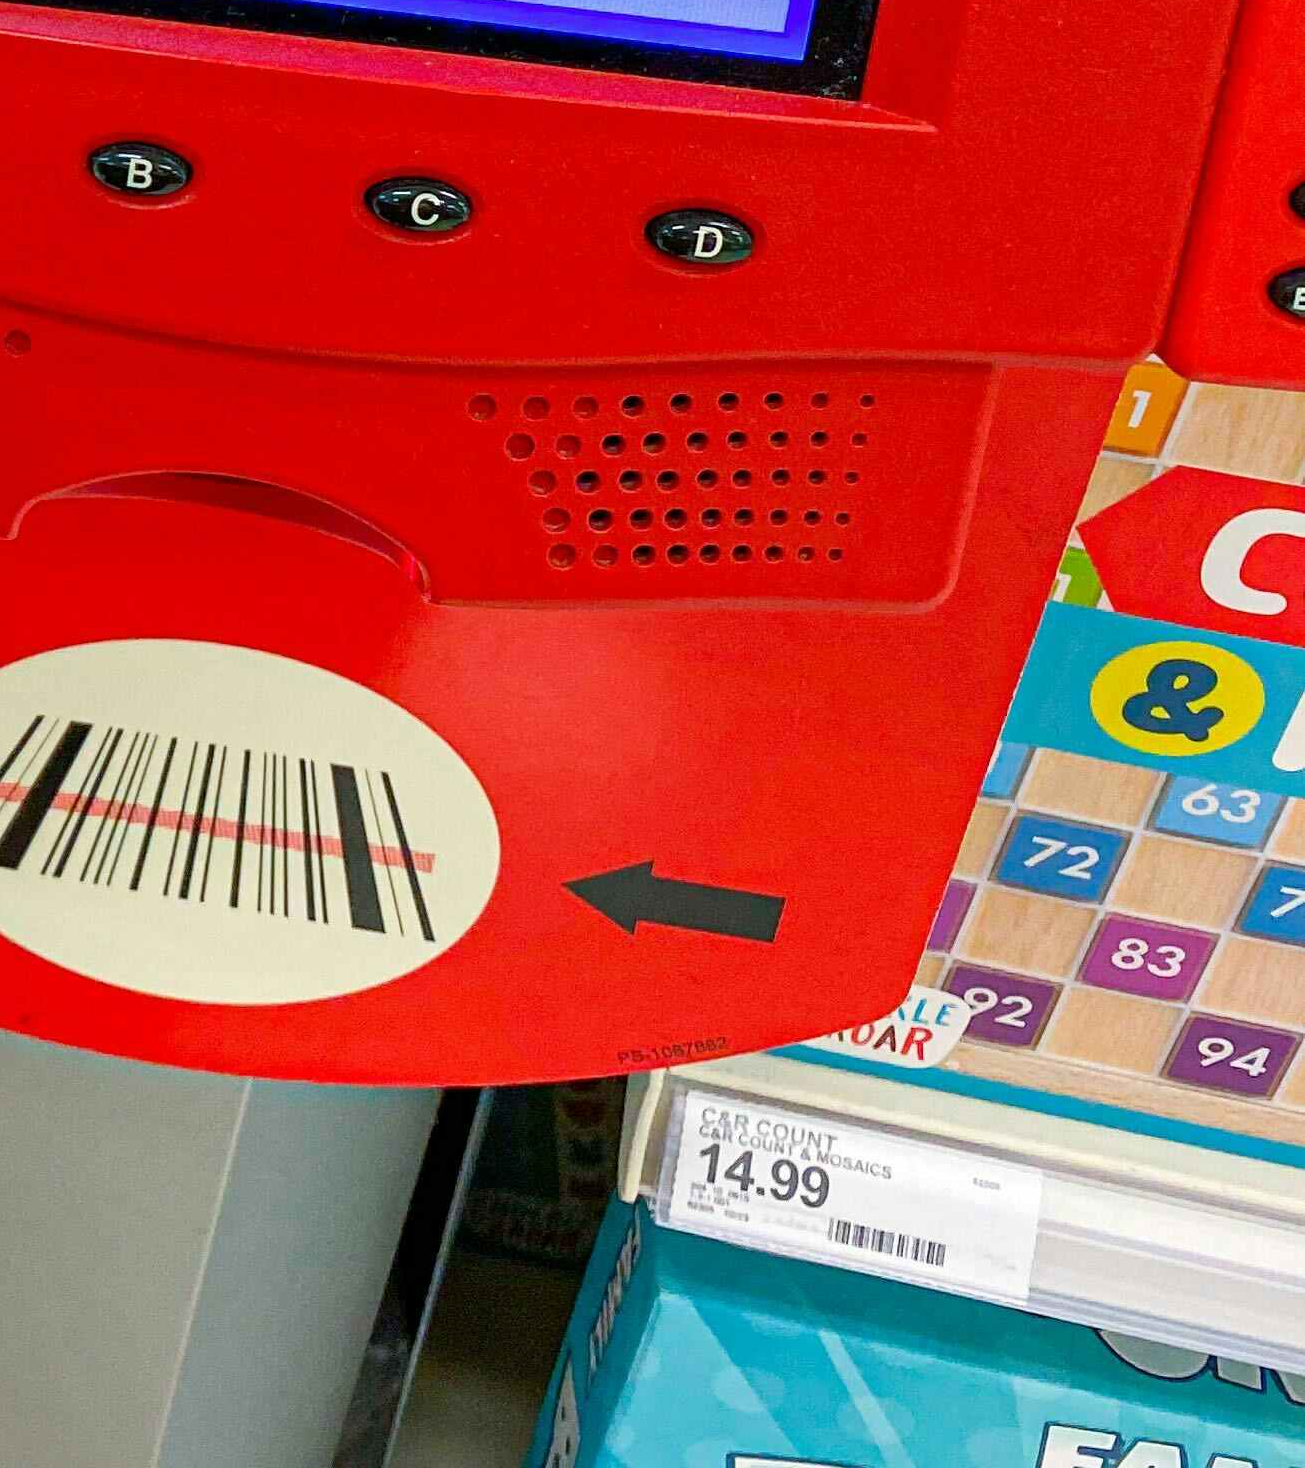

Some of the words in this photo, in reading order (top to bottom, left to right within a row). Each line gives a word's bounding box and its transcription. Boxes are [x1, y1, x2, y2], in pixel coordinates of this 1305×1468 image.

[126, 157, 153, 190] B
[410, 193, 441, 226] C
[693, 226, 725, 259] D
[1200, 508, 1305, 616] C
[1122, 658, 1224, 742] &
[1181, 783, 1261, 824] 63
[1022, 835, 1099, 880] 72
[1270, 885, 1305, 918] 7
[1111, 937, 1186, 978] 83
[963, 986, 1033, 1027] 92
[1197, 1036, 1269, 1078] 94
[701, 1106, 749, 1134] C&R
[757, 1119, 839, 1152] COUNT
[699, 1124, 733, 1143] C&R
[739, 1132, 793, 1157] COUNT
[800, 1147, 813, 1162] &
[816, 1150, 893, 1180] MOSAICS
[699, 1143, 831, 1209] 14.99
